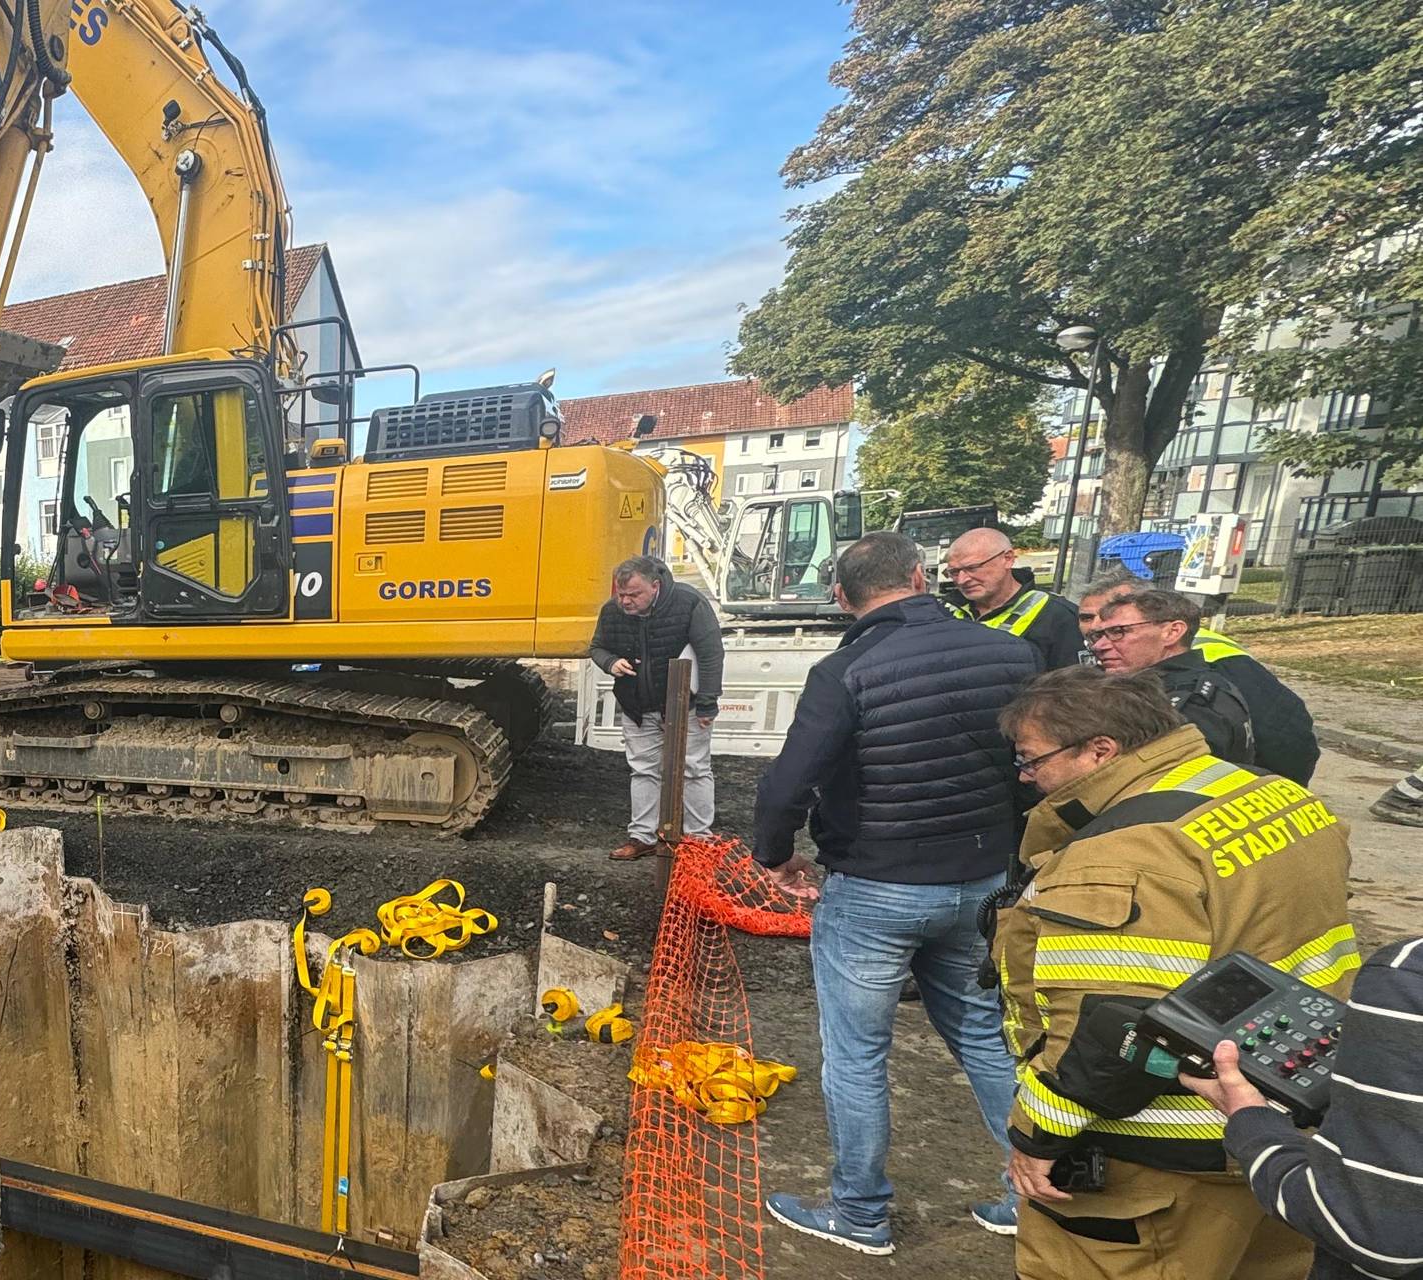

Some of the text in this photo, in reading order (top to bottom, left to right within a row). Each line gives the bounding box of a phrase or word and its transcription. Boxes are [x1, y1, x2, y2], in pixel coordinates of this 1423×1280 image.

[378, 578, 492, 600] GORDES
[1180, 778, 1314, 850] FEUERWEH
[1212, 817, 1296, 877] STADT
